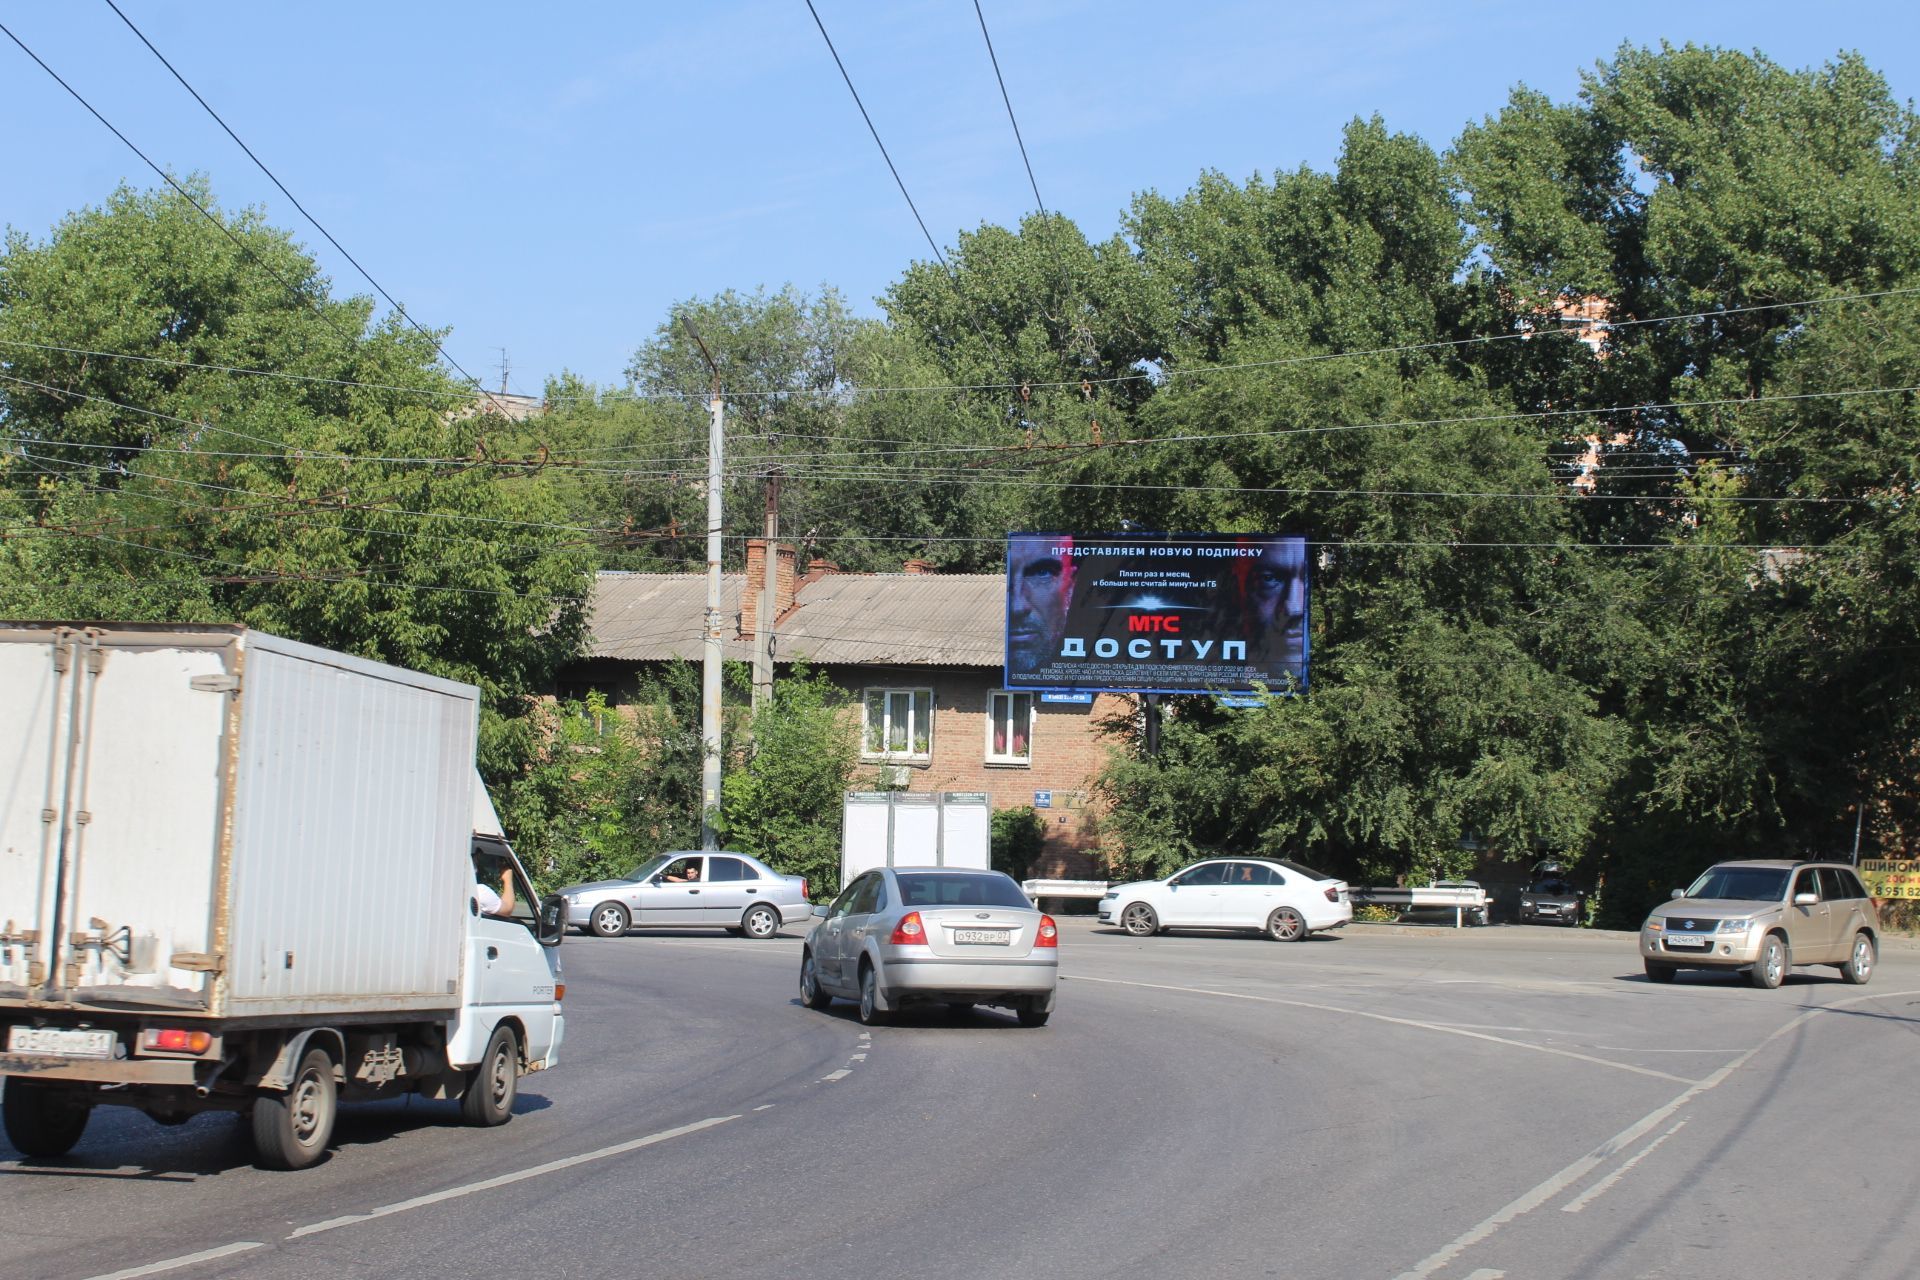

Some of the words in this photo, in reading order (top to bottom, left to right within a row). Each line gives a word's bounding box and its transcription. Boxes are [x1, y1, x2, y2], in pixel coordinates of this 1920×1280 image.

[1051, 547, 1145, 556] ПРЕДСТАВЛЯЕМ
[1149, 547, 1193, 556] НОВУЮ
[1197, 548, 1263, 557] ПОДПИСКУ
[1099, 579, 1128, 587] больше
[1128, 615, 1180, 632] МТС
[1060, 638, 1246, 660] ДОСТУП
[1886, 875, 1906, 883] 200
[1875, 887, 1882, 896] 8
[1885, 887, 1904, 896] 951
